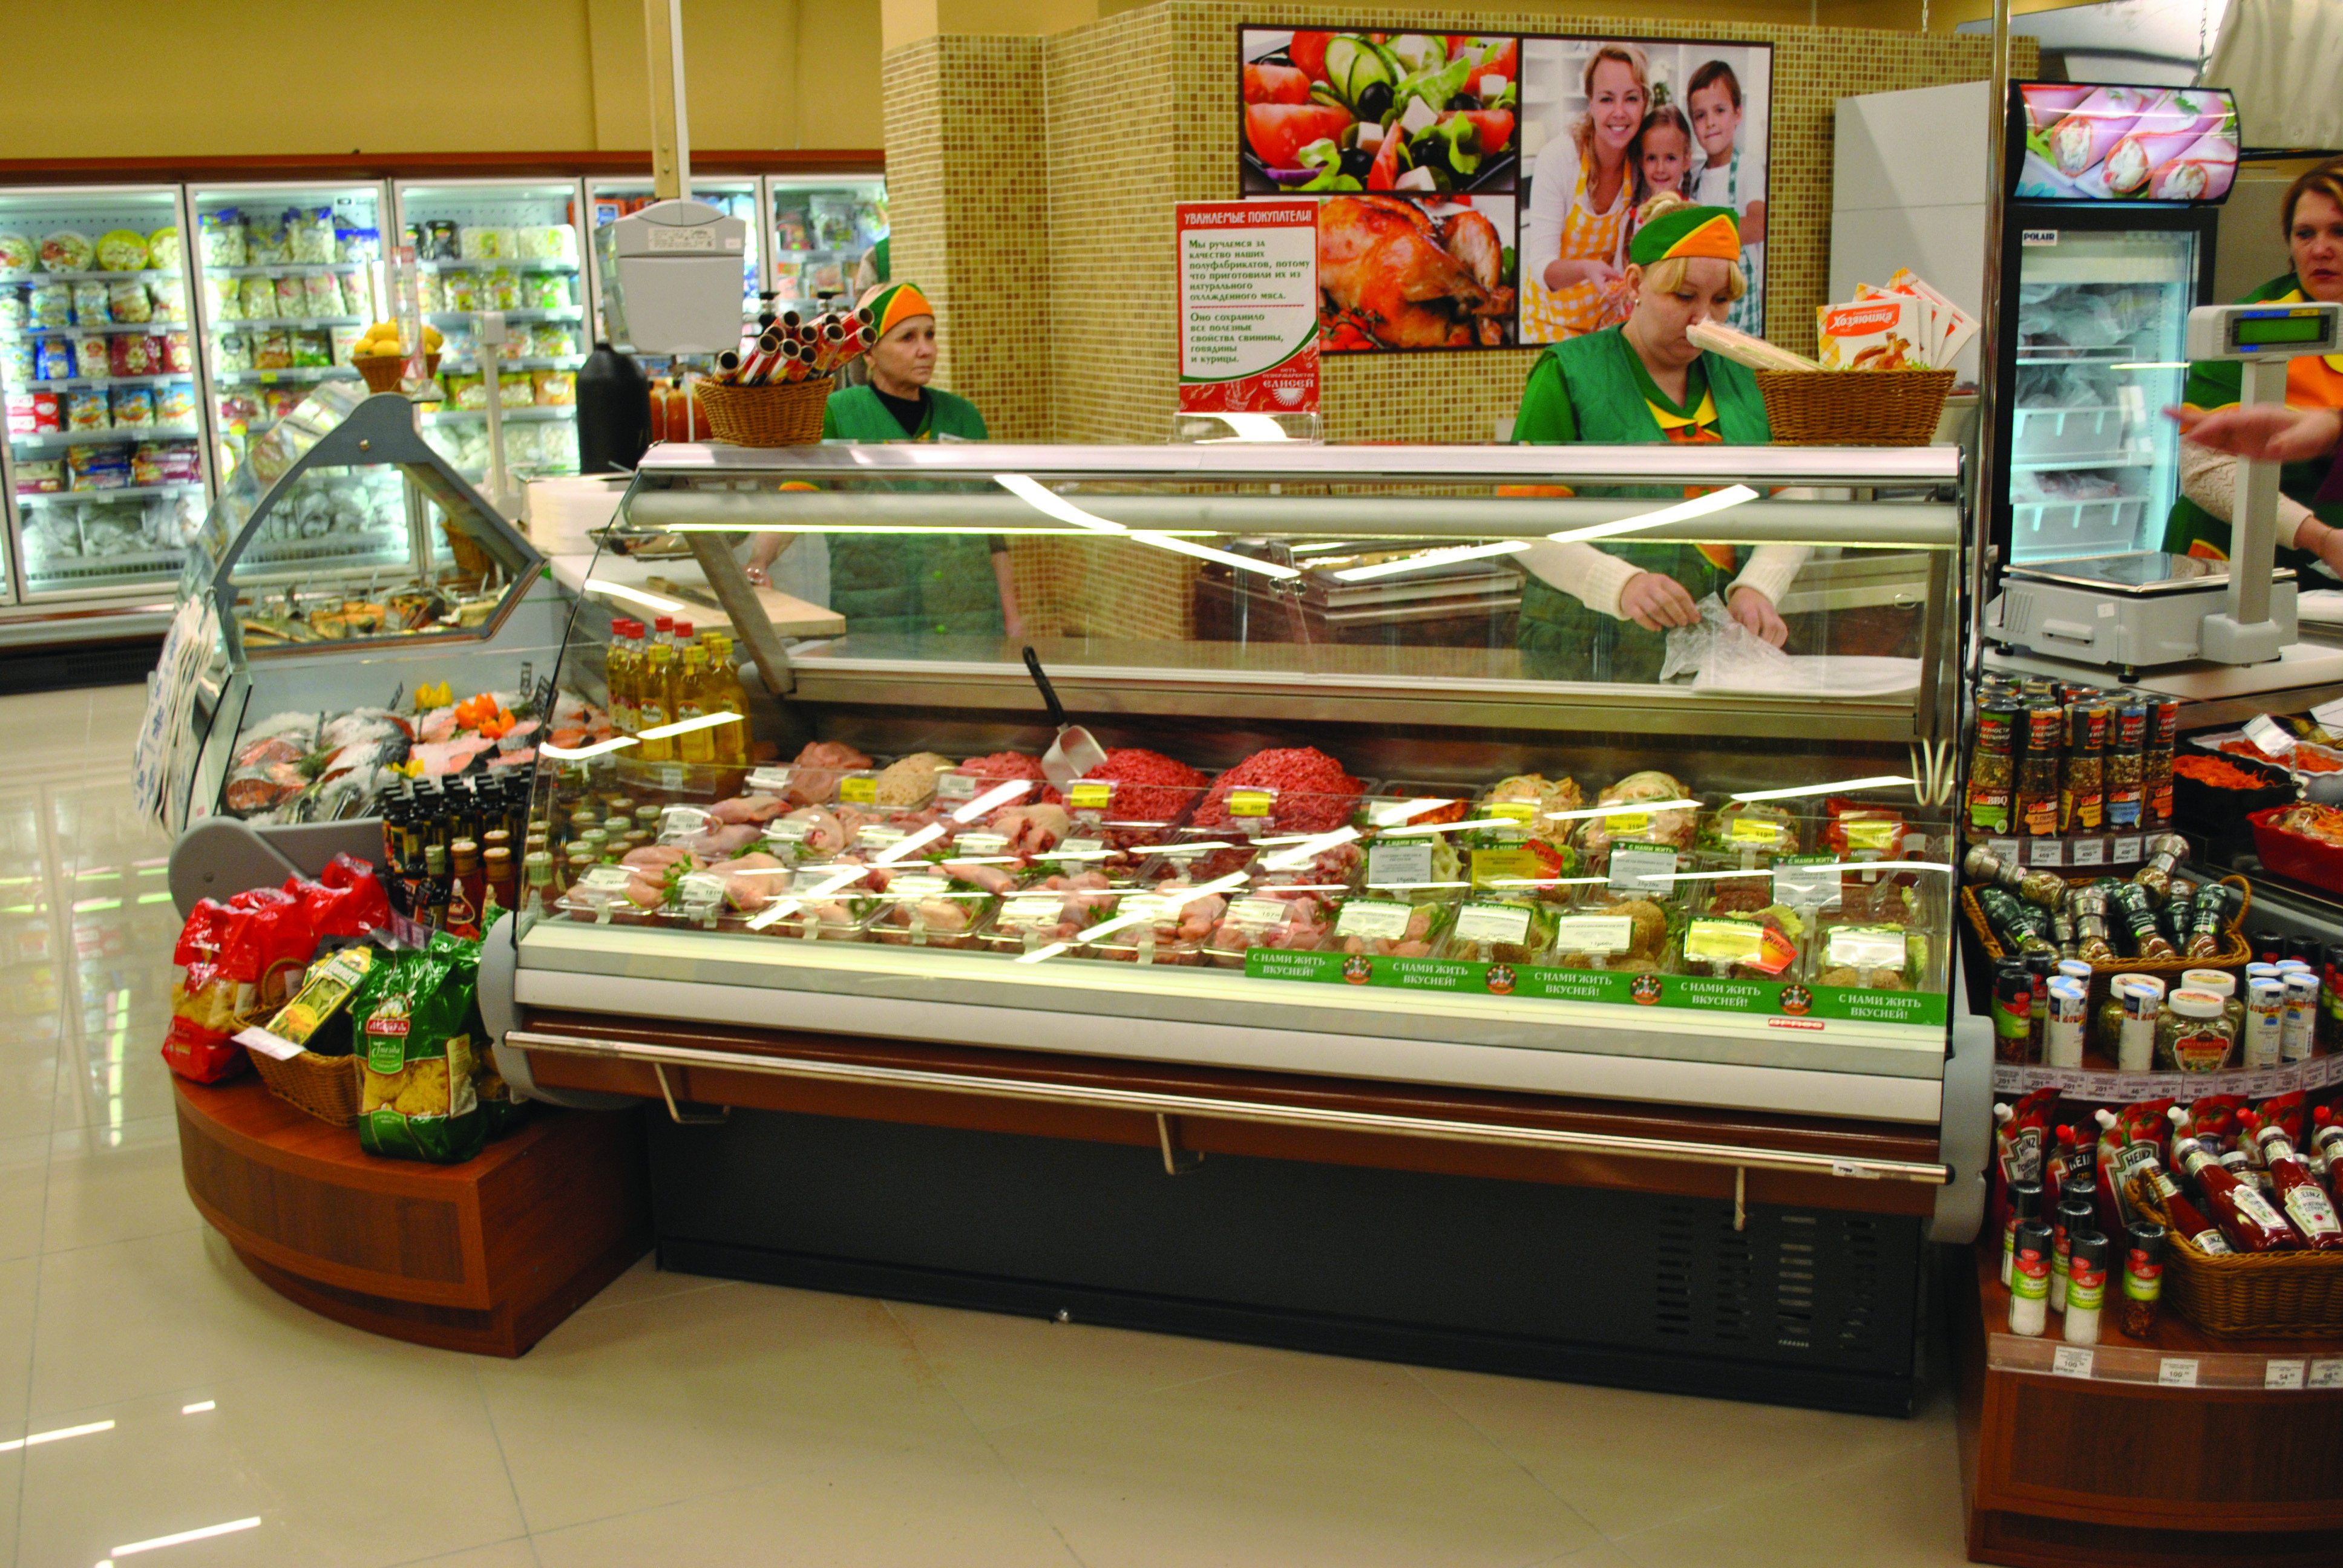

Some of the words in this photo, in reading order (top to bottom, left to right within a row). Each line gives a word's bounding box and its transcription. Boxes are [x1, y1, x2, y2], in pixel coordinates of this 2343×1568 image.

[1184, 212, 1246, 225] УВАЖАЕМЫЕ
[1248, 210, 1312, 223] ПОКУПАТЕЛИ!
[1189, 240, 1205, 249] Мы
[1190, 312, 1211, 322] Оно
[1253, 953, 1260, 962] С
[1262, 954, 1291, 964] НАМИ
[1294, 956, 1326, 967] ЖИТЬ
[1262, 965, 1314, 978] ВКУСНЕЙ!
[1392, 962, 1400, 972] С
[1401, 963, 1433, 973] НАМИ
[1435, 965, 1469, 976] ЖИТЬ
[1403, 974, 1457, 987] ВКУСНЕЙ!
[1535, 972, 1542, 981] С
[1544, 973, 1576, 984] НАМИ
[1578, 974, 1613, 986] ЖИТЬ
[1545, 984, 1600, 998] ВКУСНЕЙ!
[1680, 982, 1688, 992] С
[1690, 983, 1724, 994] НАМИ
[1726, 985, 1762, 996] ЖИТЬ
[1692, 995, 1749, 1008] ВКУСНЕЙ!
[1838, 994, 1846, 1004] С
[1849, 995, 1883, 1006] НАМИ
[1885, 996, 1922, 1008] ЖИТЬ
[1850, 1006, 1909, 1020] ВКУСНЕЙ!
[2069, 1154, 2092, 1171] HEI
[2126, 1149, 2151, 1166] HEINZ
